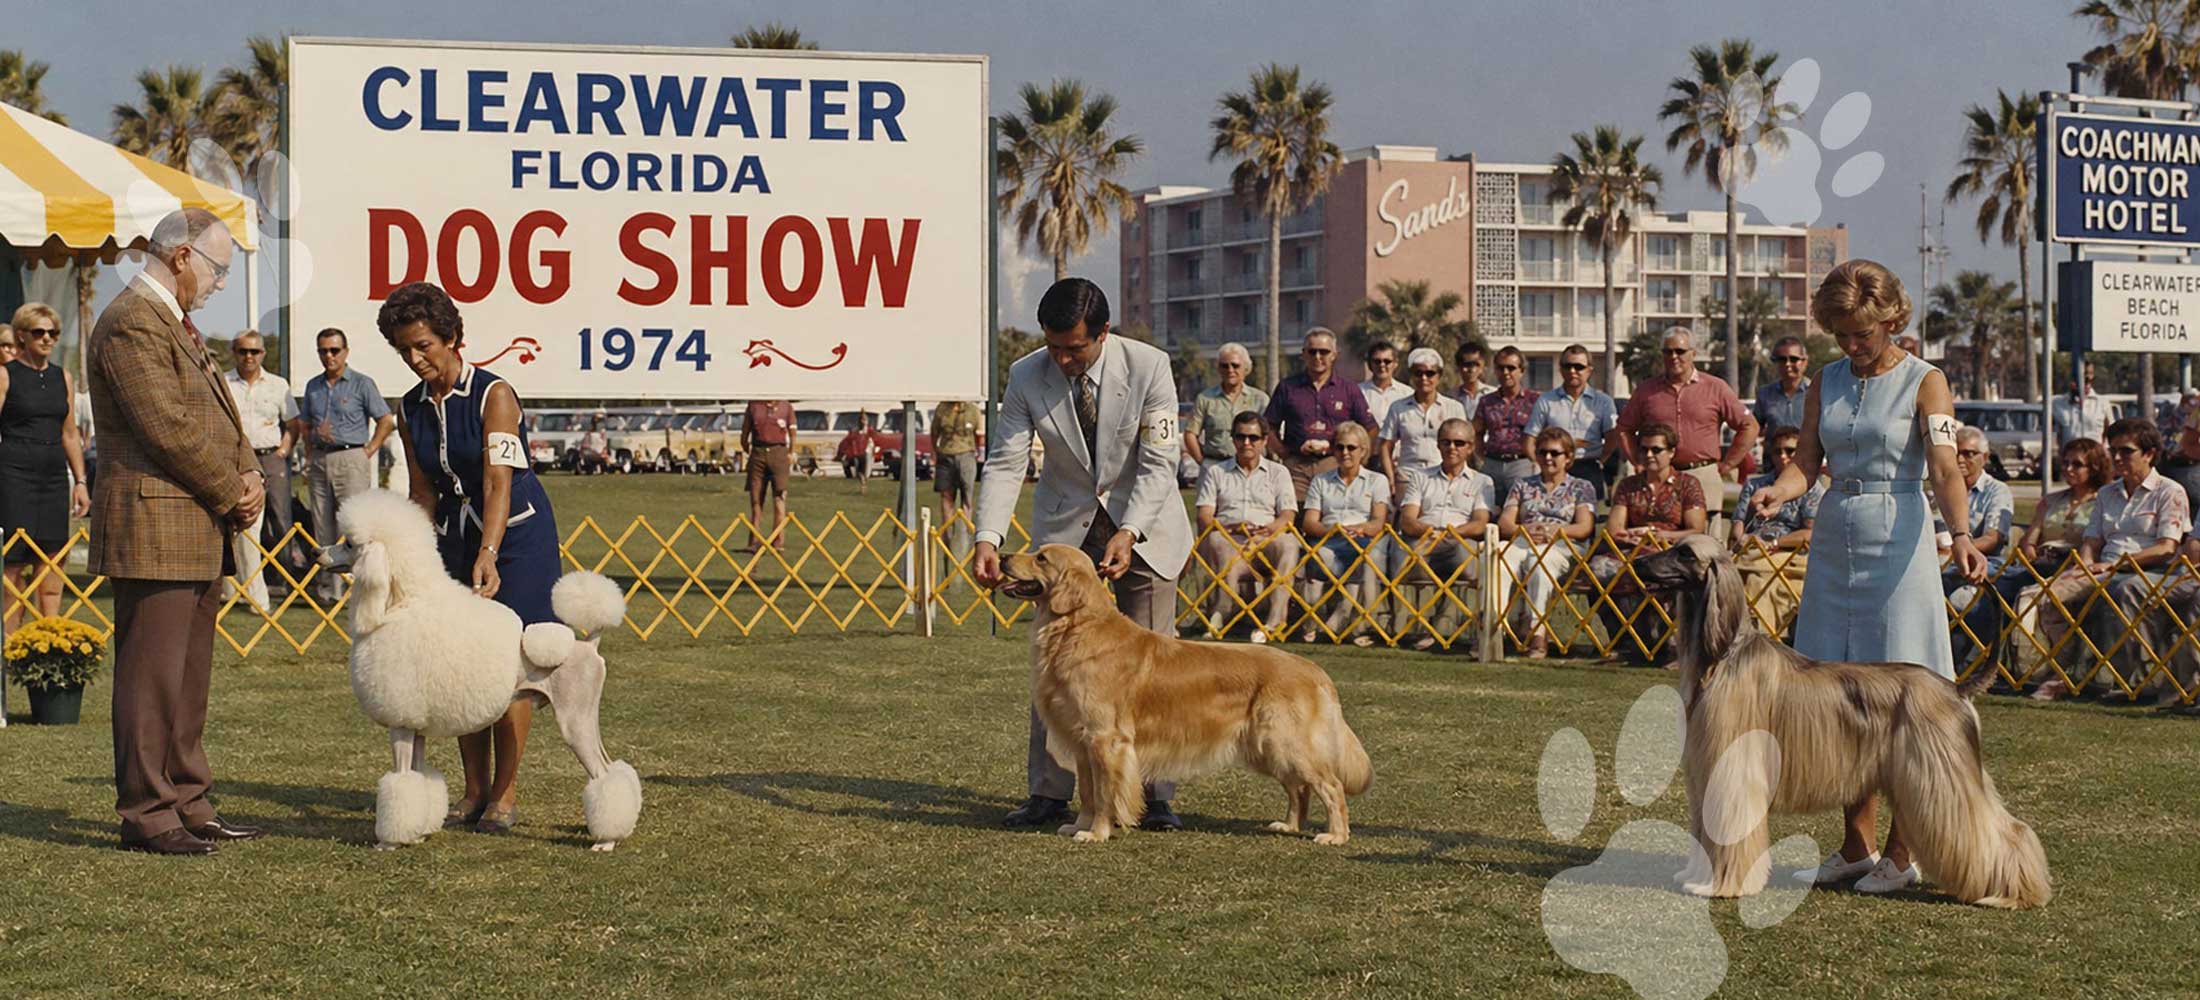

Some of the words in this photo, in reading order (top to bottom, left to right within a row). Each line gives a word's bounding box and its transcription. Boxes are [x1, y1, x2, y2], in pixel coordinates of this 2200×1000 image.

[362, 66, 906, 142] CLEARWATER
[511, 150, 771, 194] FLORIDA
[2083, 163, 2189, 198] MOTOR
[1375, 175, 1470, 258] Sands
[2084, 199, 2187, 233] HOTEL
[367, 208, 571, 304] DOG
[617, 212, 922, 308] SHOW
[2127, 298, 2179, 317] BEACH
[578, 327, 712, 372] 1974
[2120, 321, 2188, 341] FLORIDA
